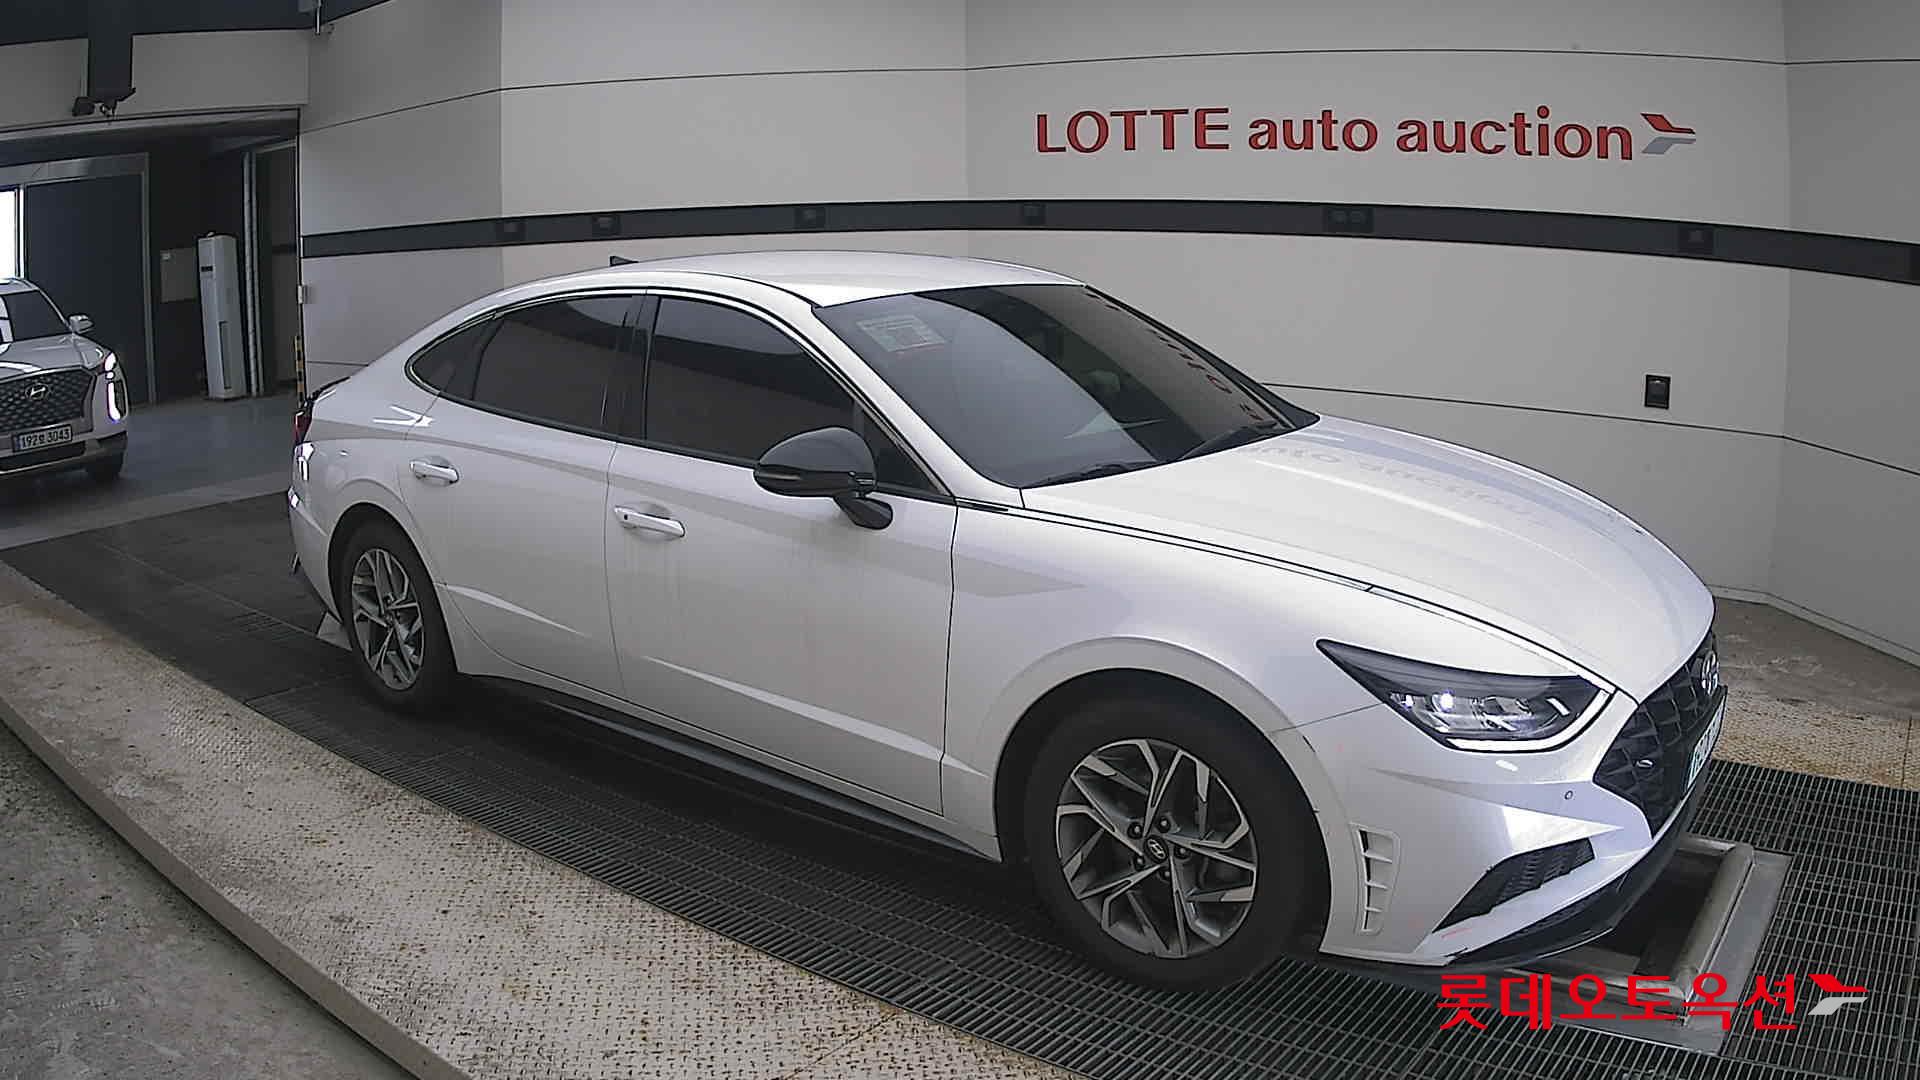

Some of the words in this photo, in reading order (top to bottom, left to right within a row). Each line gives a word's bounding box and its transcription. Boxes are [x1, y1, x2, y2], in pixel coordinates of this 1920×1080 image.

[1037, 107, 1229, 153] LOTTE
[1248, 110, 1379, 152] auto
[1396, 106, 1634, 161] auction
[47, 428, 70, 443] 3043
